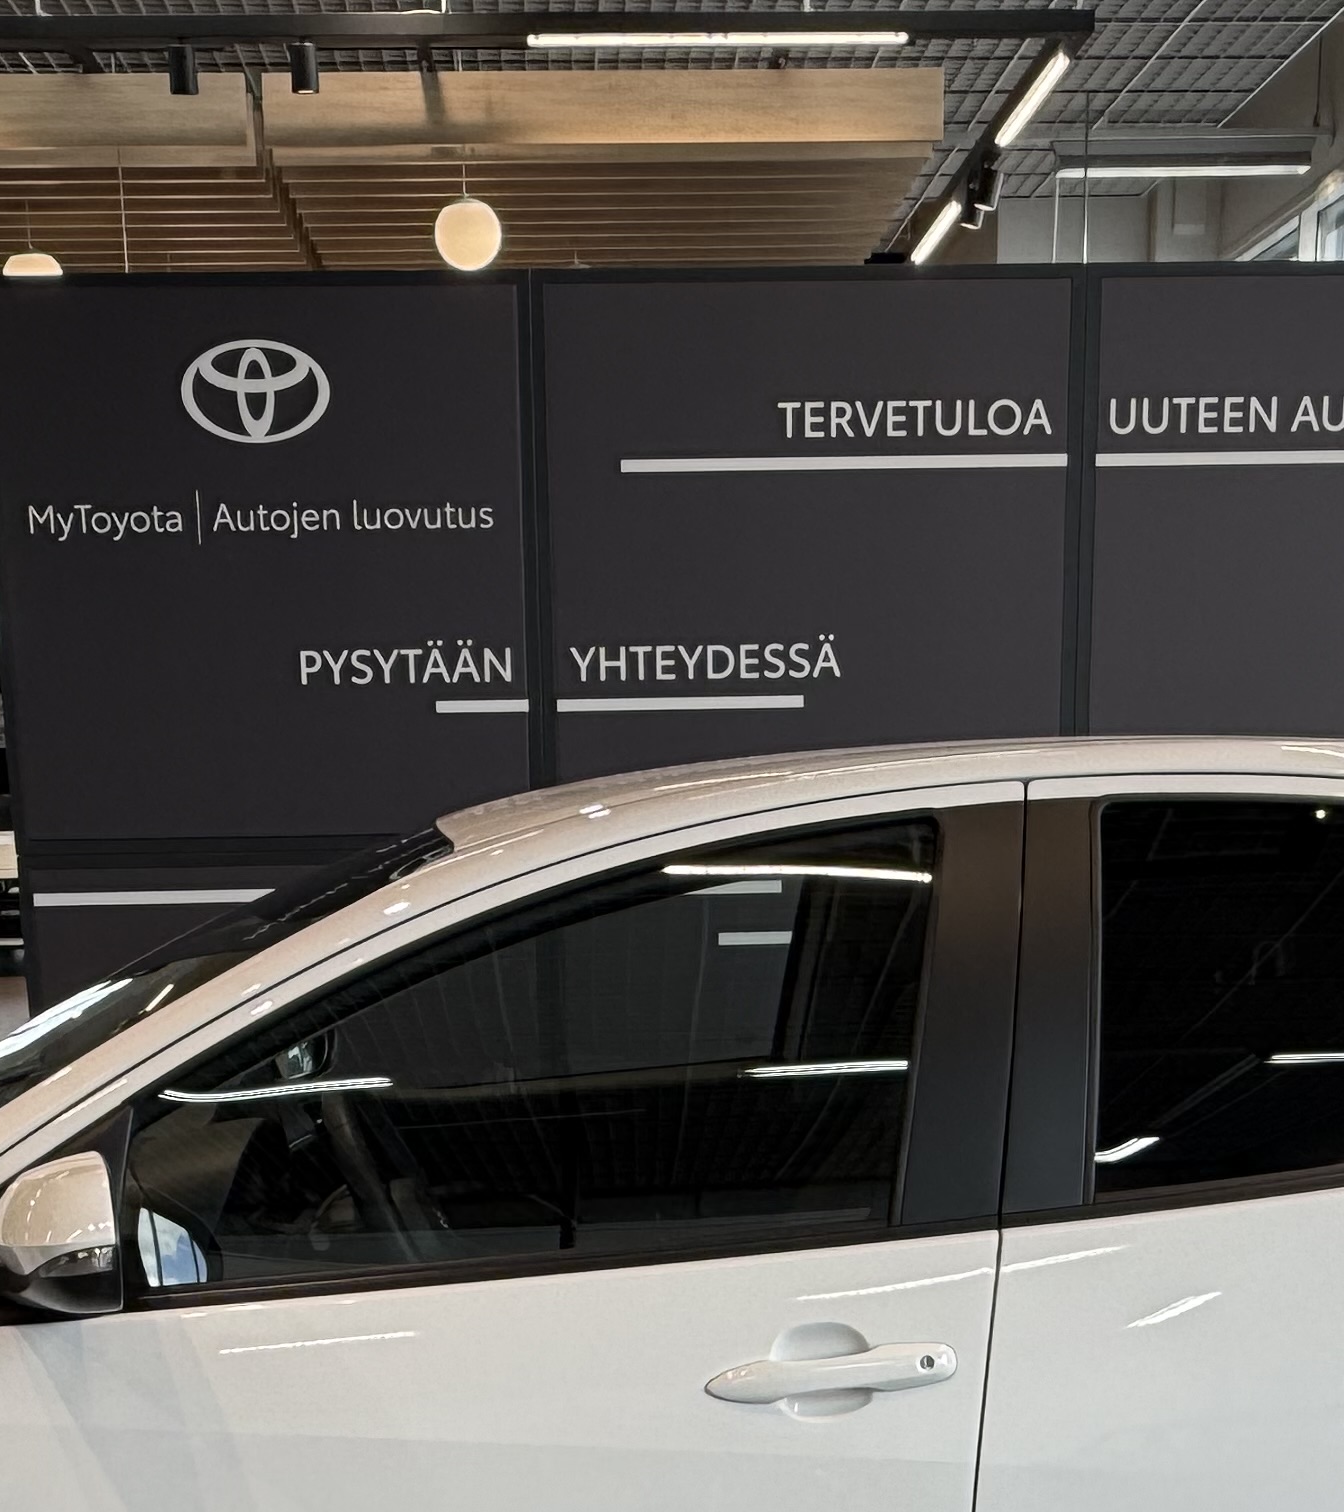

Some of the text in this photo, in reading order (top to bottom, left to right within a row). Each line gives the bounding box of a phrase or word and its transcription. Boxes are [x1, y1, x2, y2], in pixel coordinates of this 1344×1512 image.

[777, 398, 1053, 439] TERVETULOA
[1109, 395, 1278, 435] UUTEEN
[28, 499, 494, 542] MyToyota Autojen luovutus
[299, 633, 841, 686] PYSYTÄÄN YHTEYDESSÄ
